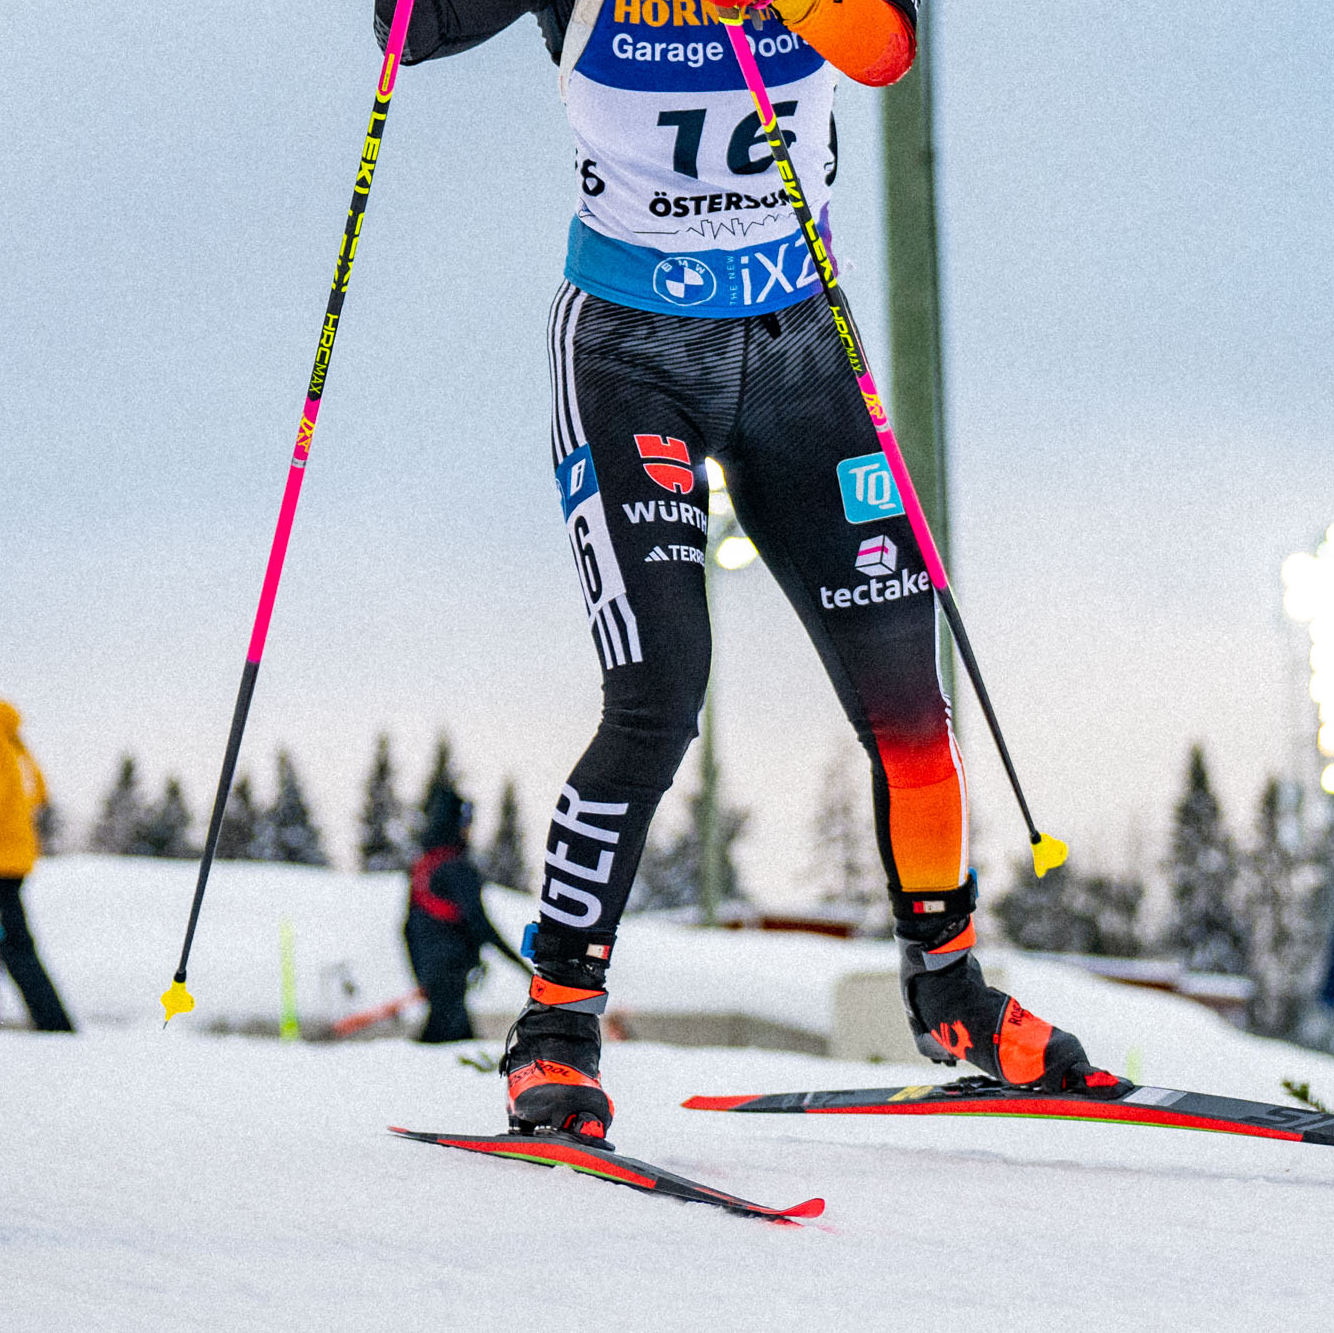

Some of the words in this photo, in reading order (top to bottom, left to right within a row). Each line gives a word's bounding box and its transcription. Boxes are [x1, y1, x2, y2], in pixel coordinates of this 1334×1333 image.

[612, 33, 724, 68] Garage
[745, 32, 810, 58] oor
[354, 111, 387, 195] LEKI
[656, 100, 799, 180] 16
[621, 500, 708, 537] WÜRTH
[819, 568, 931, 610] tectake
[540, 781, 630, 928] GER
